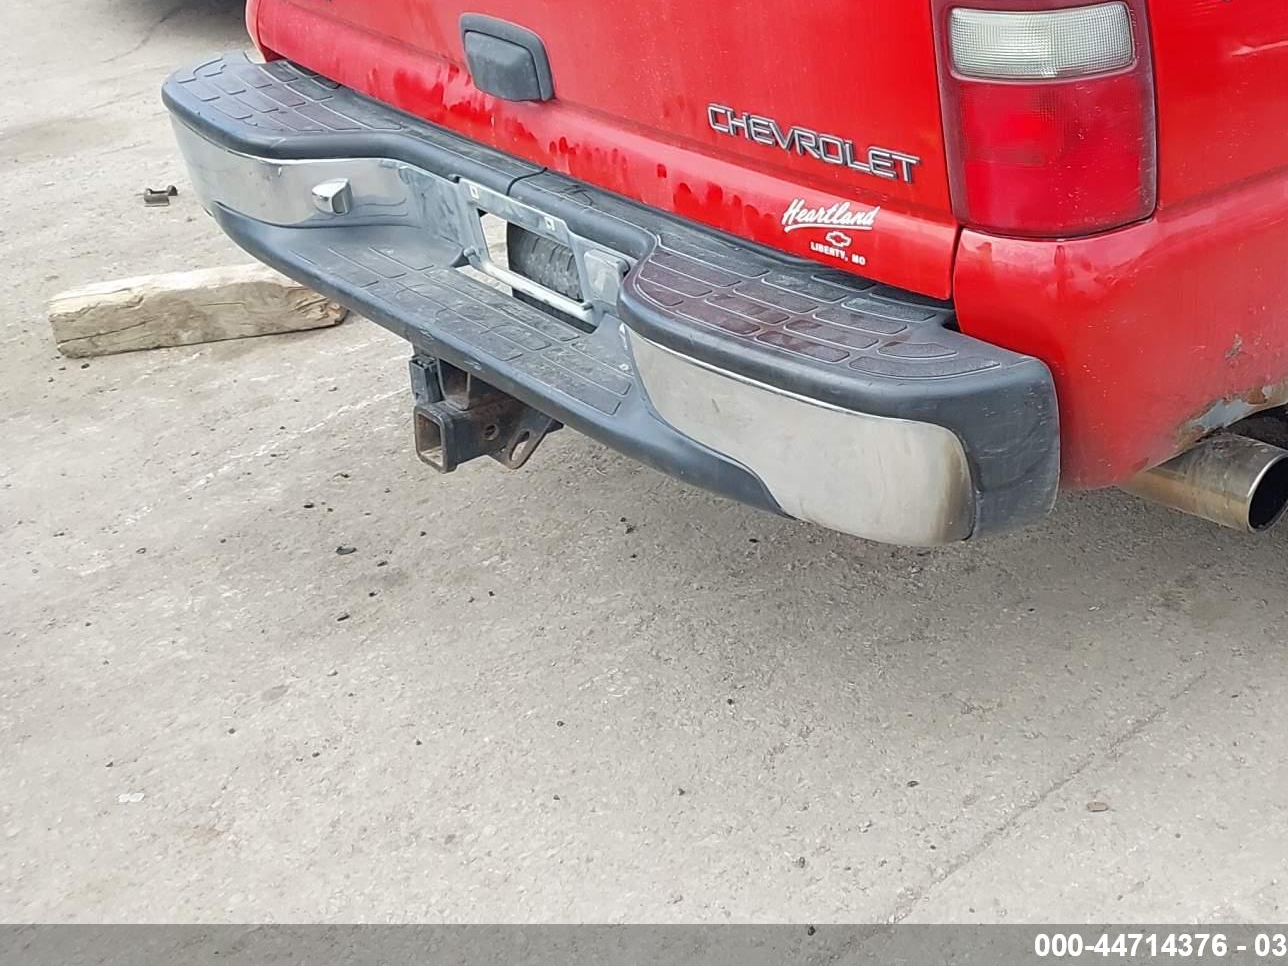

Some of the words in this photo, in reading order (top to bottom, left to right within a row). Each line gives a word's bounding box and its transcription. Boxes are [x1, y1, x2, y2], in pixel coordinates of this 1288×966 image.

[707, 103, 920, 183] CHEVROLET
[781, 198, 880, 232] Heartland
[810, 241, 849, 261] LIBERTY,
[851, 253, 866, 266] MO
